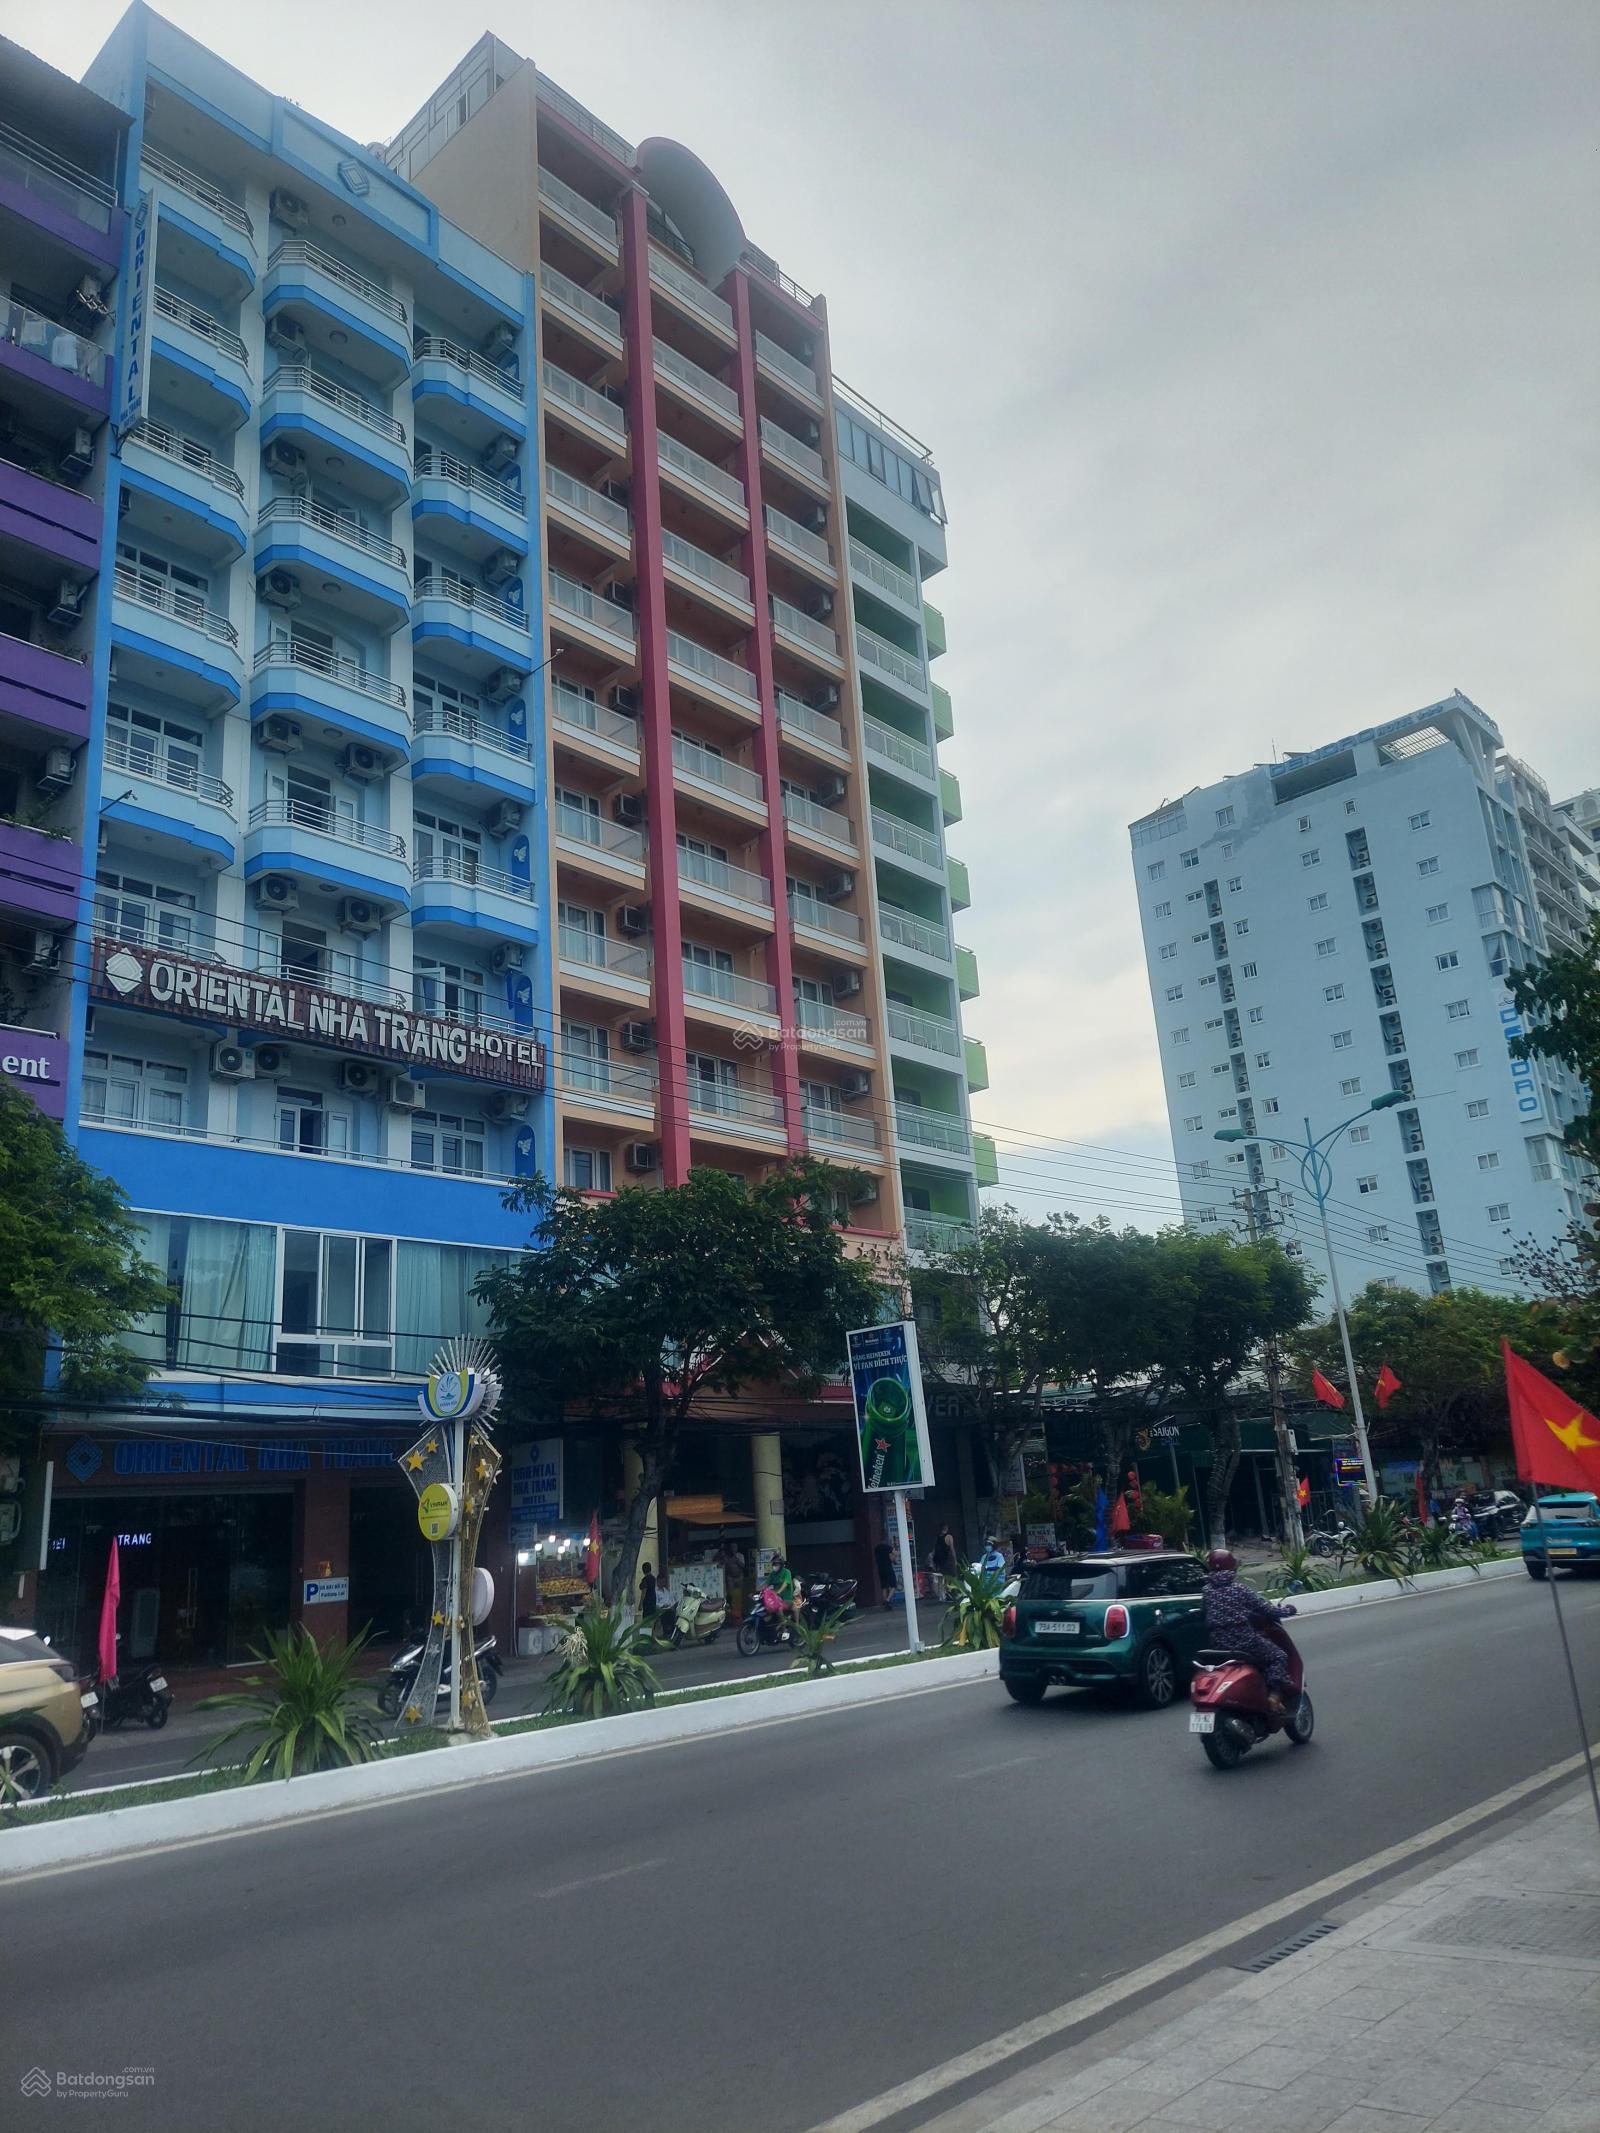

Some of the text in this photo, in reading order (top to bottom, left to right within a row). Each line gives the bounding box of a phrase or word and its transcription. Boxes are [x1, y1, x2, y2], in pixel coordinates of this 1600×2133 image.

[127, 227, 146, 404] ORIENTAL
[149, 957, 544, 1068] ORIENTAL NHA TRANG HOTEL
[1152, 1425, 1180, 1437] SAIGON
[113, 1438, 396, 1475] ORIENTAL NHA TRANG
[513, 1462, 557, 1480] ORIENTAL
[532, 1478, 557, 1493] TRANG
[117, 1532, 152, 1546] TRANG
[306, 1583, 319, 1601] P
